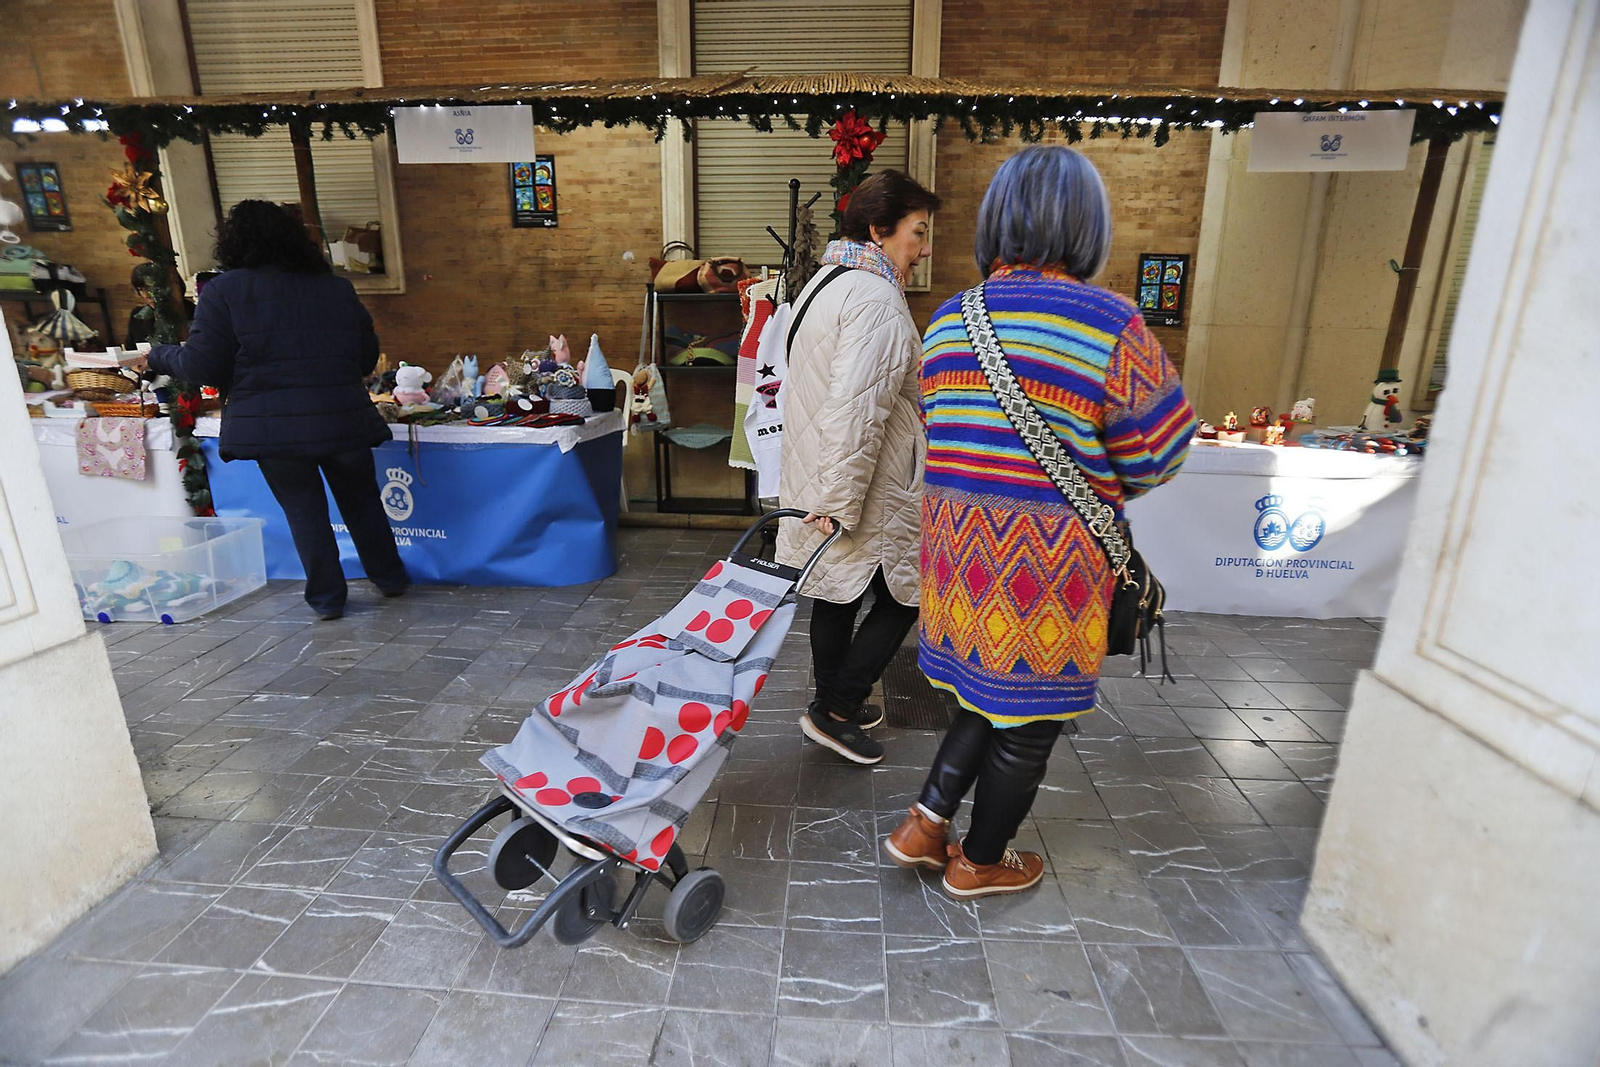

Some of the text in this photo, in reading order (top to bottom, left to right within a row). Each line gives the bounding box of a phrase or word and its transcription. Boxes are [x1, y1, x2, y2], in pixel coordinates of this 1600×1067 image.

[1302, 114, 1327, 122] OXFAM
[1214, 556, 1355, 570] DIPUTACIÓN PROVINCIAL
[1266, 569, 1310, 579] HUELVA
